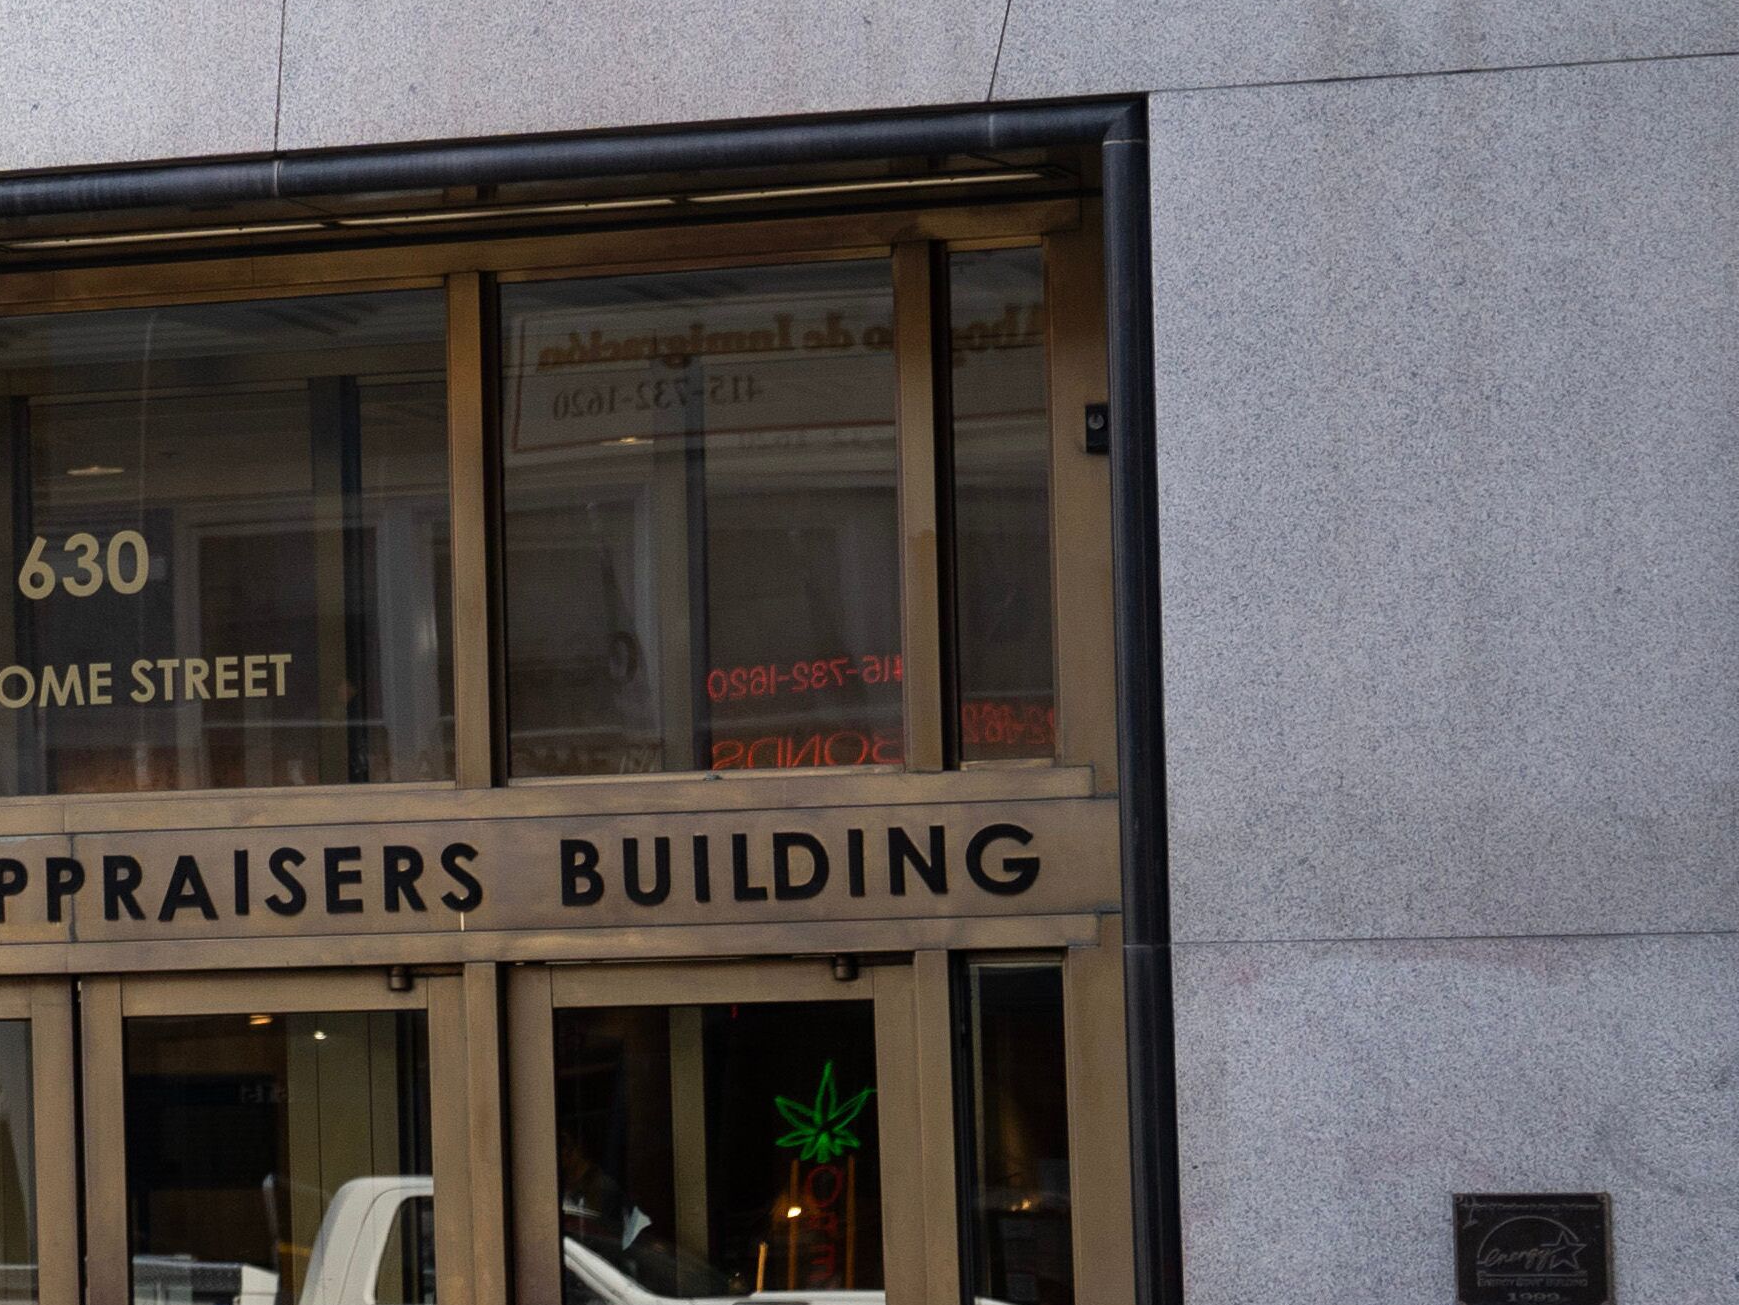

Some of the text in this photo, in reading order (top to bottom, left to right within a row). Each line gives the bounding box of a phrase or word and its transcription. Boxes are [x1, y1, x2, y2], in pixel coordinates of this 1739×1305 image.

[18, 530, 150, 600] 630
[130, 653, 293, 704] STREET
[560, 823, 1041, 907] BUILDING
